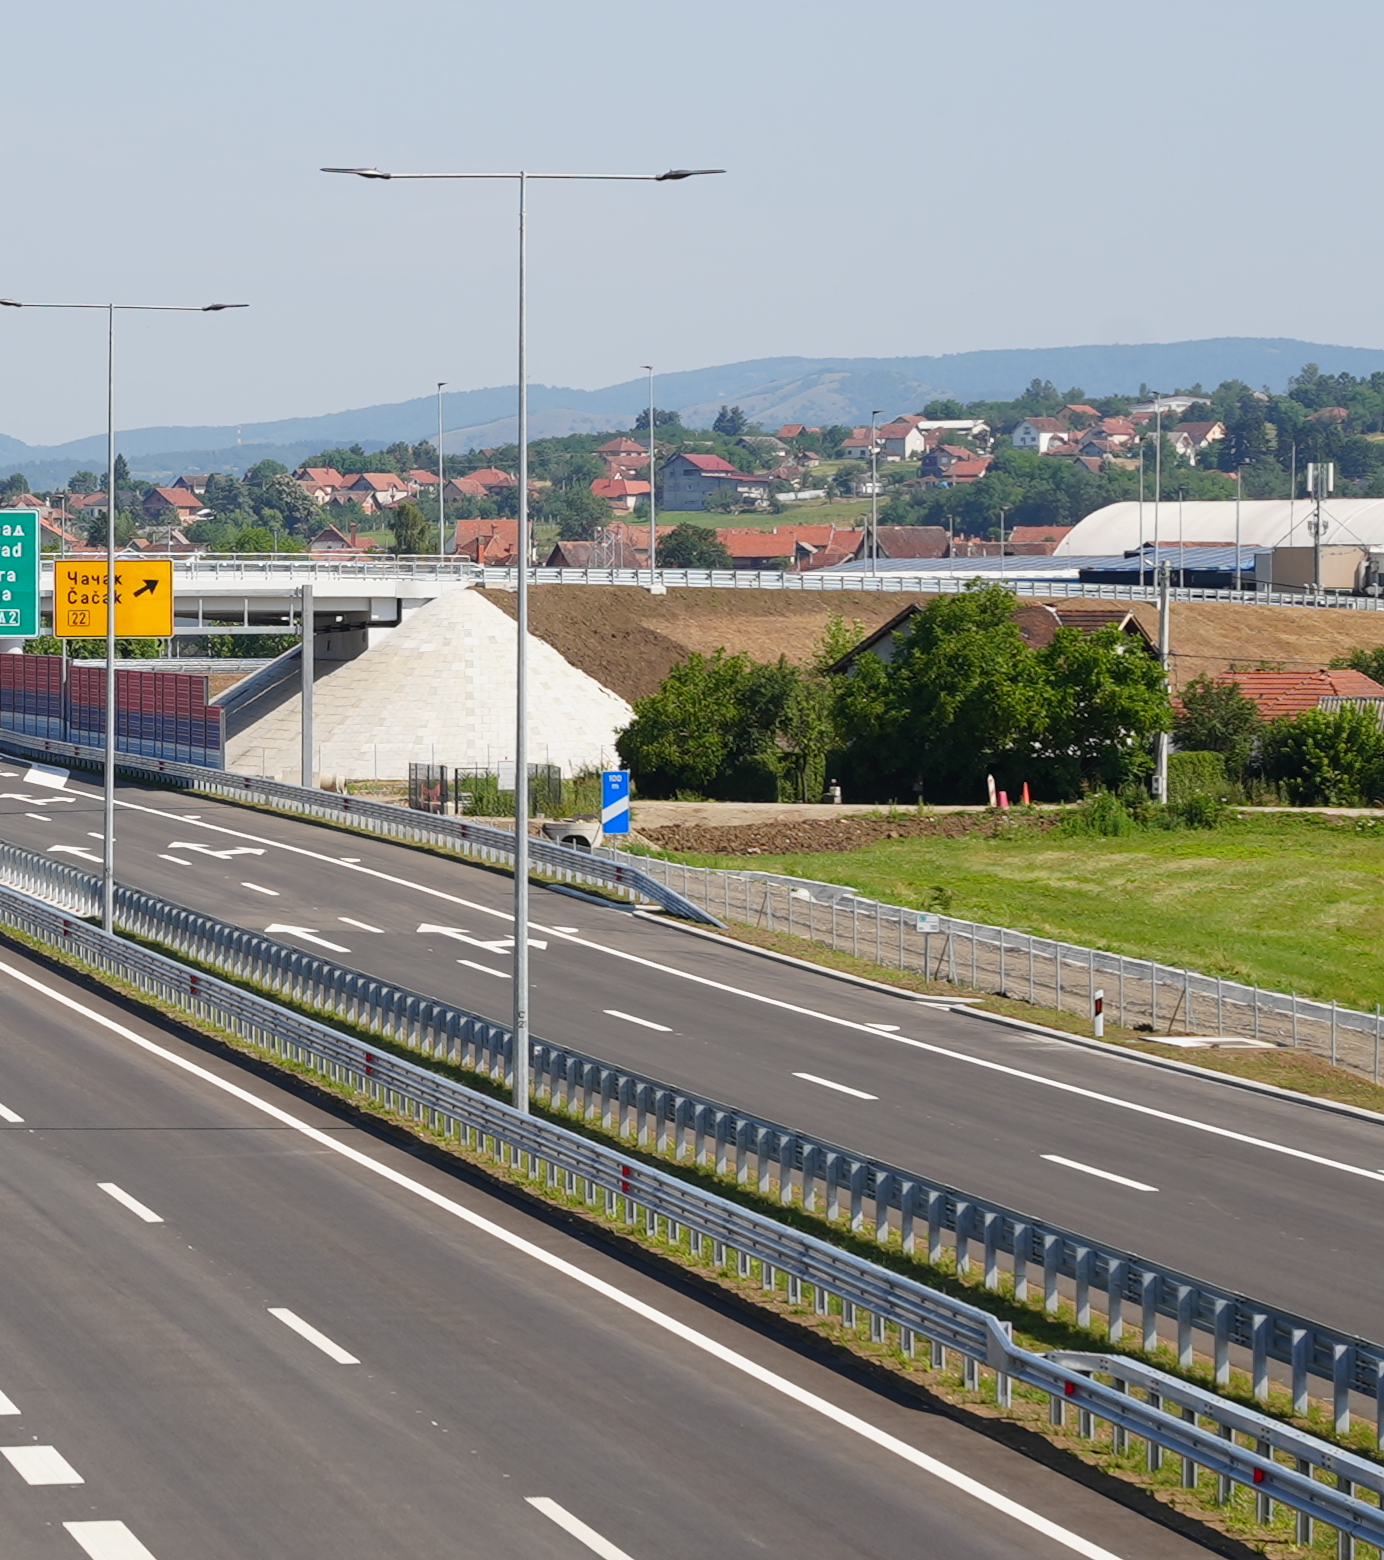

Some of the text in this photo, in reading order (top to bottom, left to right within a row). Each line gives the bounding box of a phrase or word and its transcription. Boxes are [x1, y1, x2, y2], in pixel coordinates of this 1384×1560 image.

[67, 571, 123, 586] Чачак
[67, 587, 123, 605] Čačak
[71, 612, 86, 625] 22
